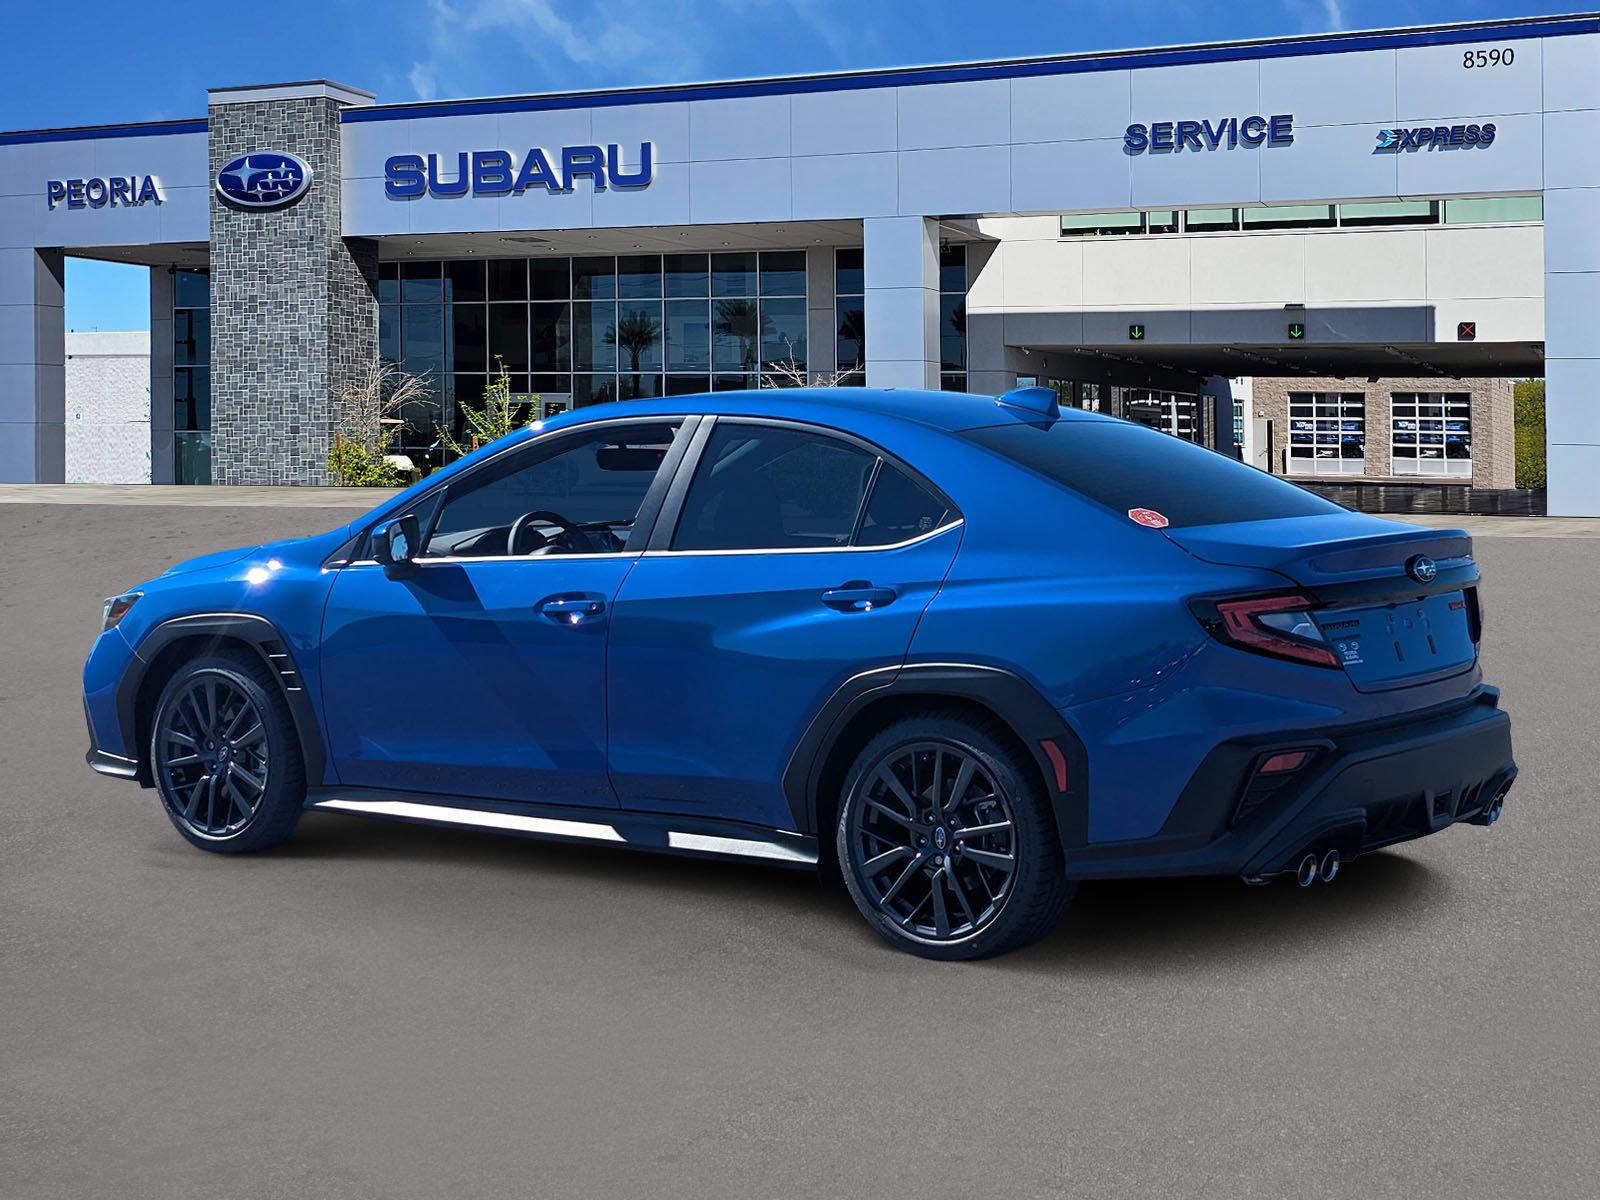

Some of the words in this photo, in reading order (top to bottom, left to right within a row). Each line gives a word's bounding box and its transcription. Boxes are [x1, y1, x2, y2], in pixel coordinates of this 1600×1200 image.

[1463, 48, 1514, 69] 8590
[1125, 114, 1294, 150] SERVICE
[1376, 123, 1497, 148] EXPRESS
[384, 141, 652, 197] SUBARU
[47, 175, 162, 209] PEORIA
